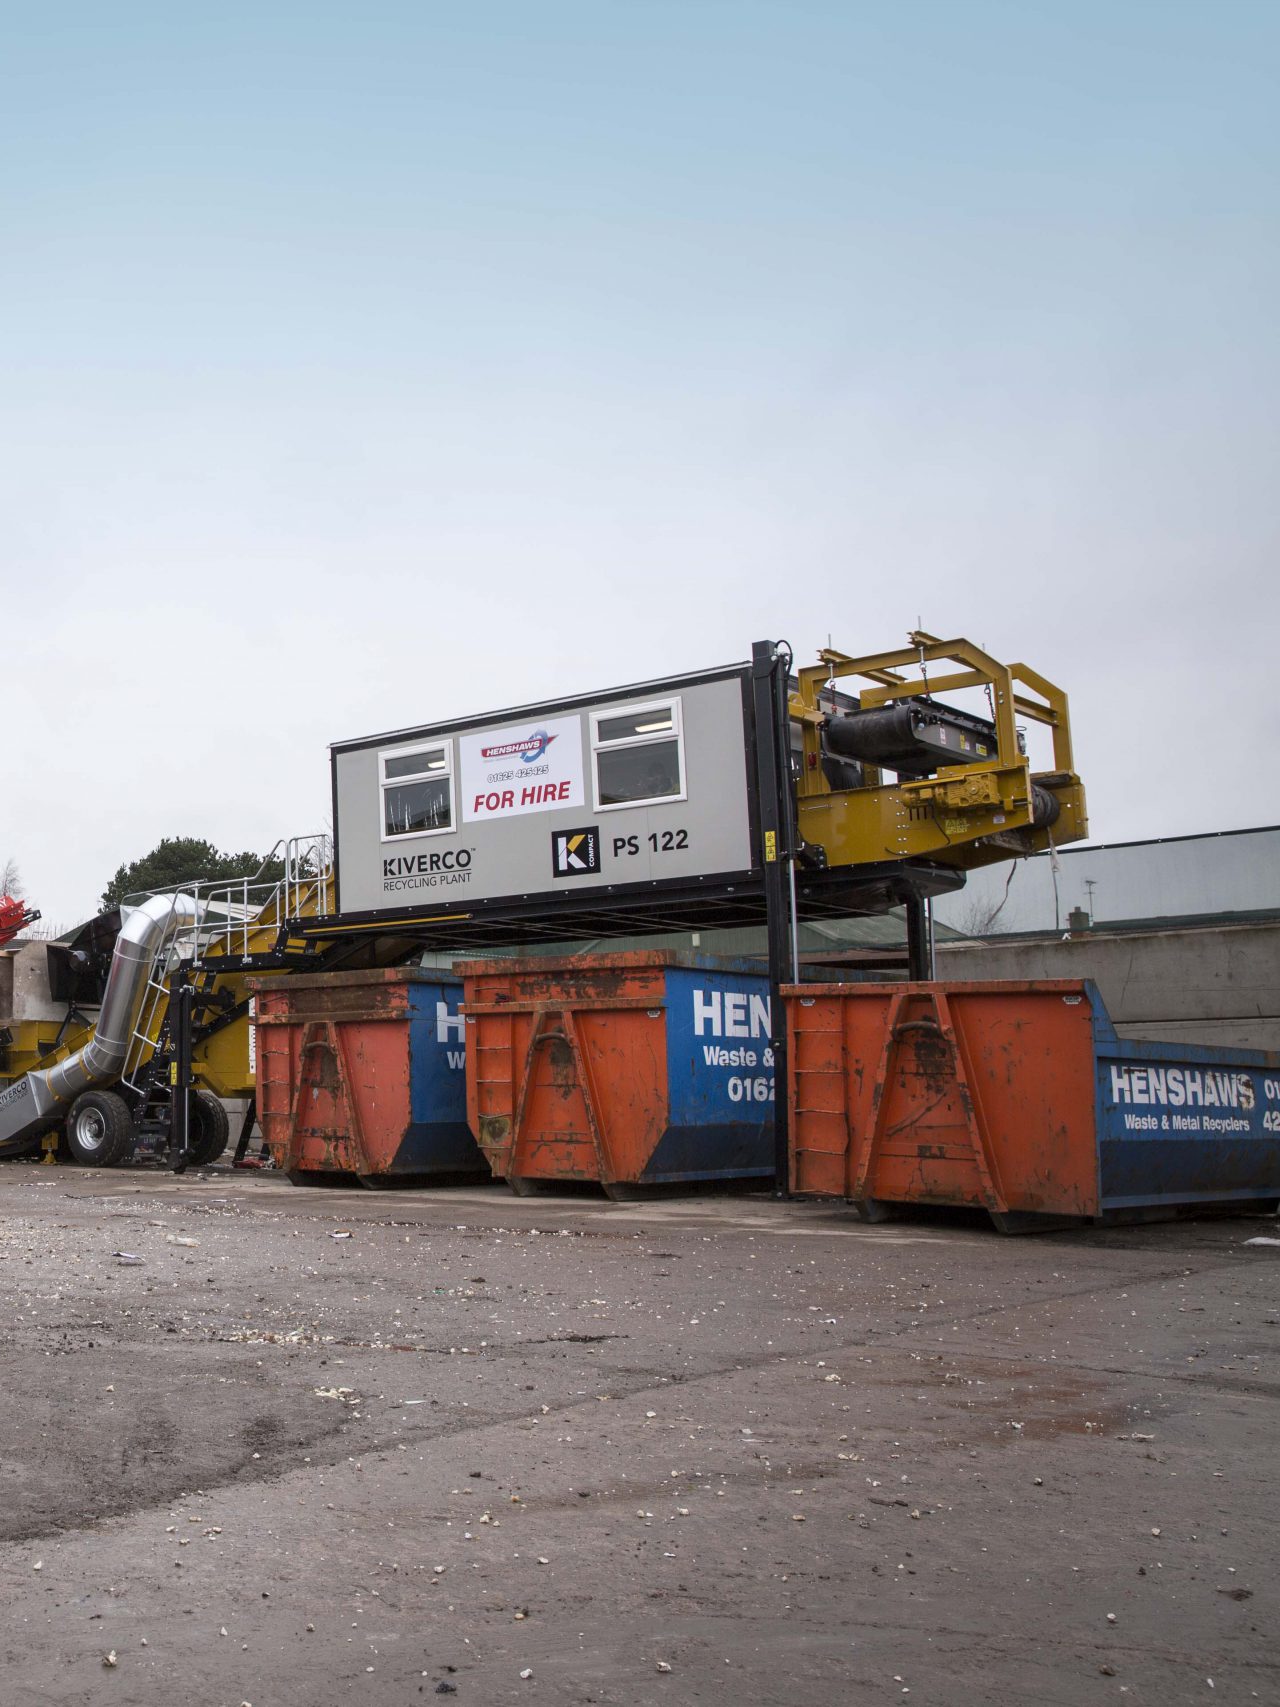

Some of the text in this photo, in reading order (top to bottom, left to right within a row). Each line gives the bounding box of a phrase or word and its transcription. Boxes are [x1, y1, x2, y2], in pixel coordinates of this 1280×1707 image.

[486, 740, 540, 756] HENSHAWS
[487, 764, 549, 783] 01625 425425
[474, 781, 571, 813] FOR HIRE
[613, 829, 688, 857] PS 122
[383, 849, 471, 876] KIVERCO
[383, 872, 472, 891] RECYCLING PLANT
[703, 1046, 775, 1067] Waste &
[1110, 1065, 1256, 1110] HENSHAWS
[1124, 1114, 1250, 1133] Waste & Metal Recyclers
[1263, 1110, 1280, 1132] 42
